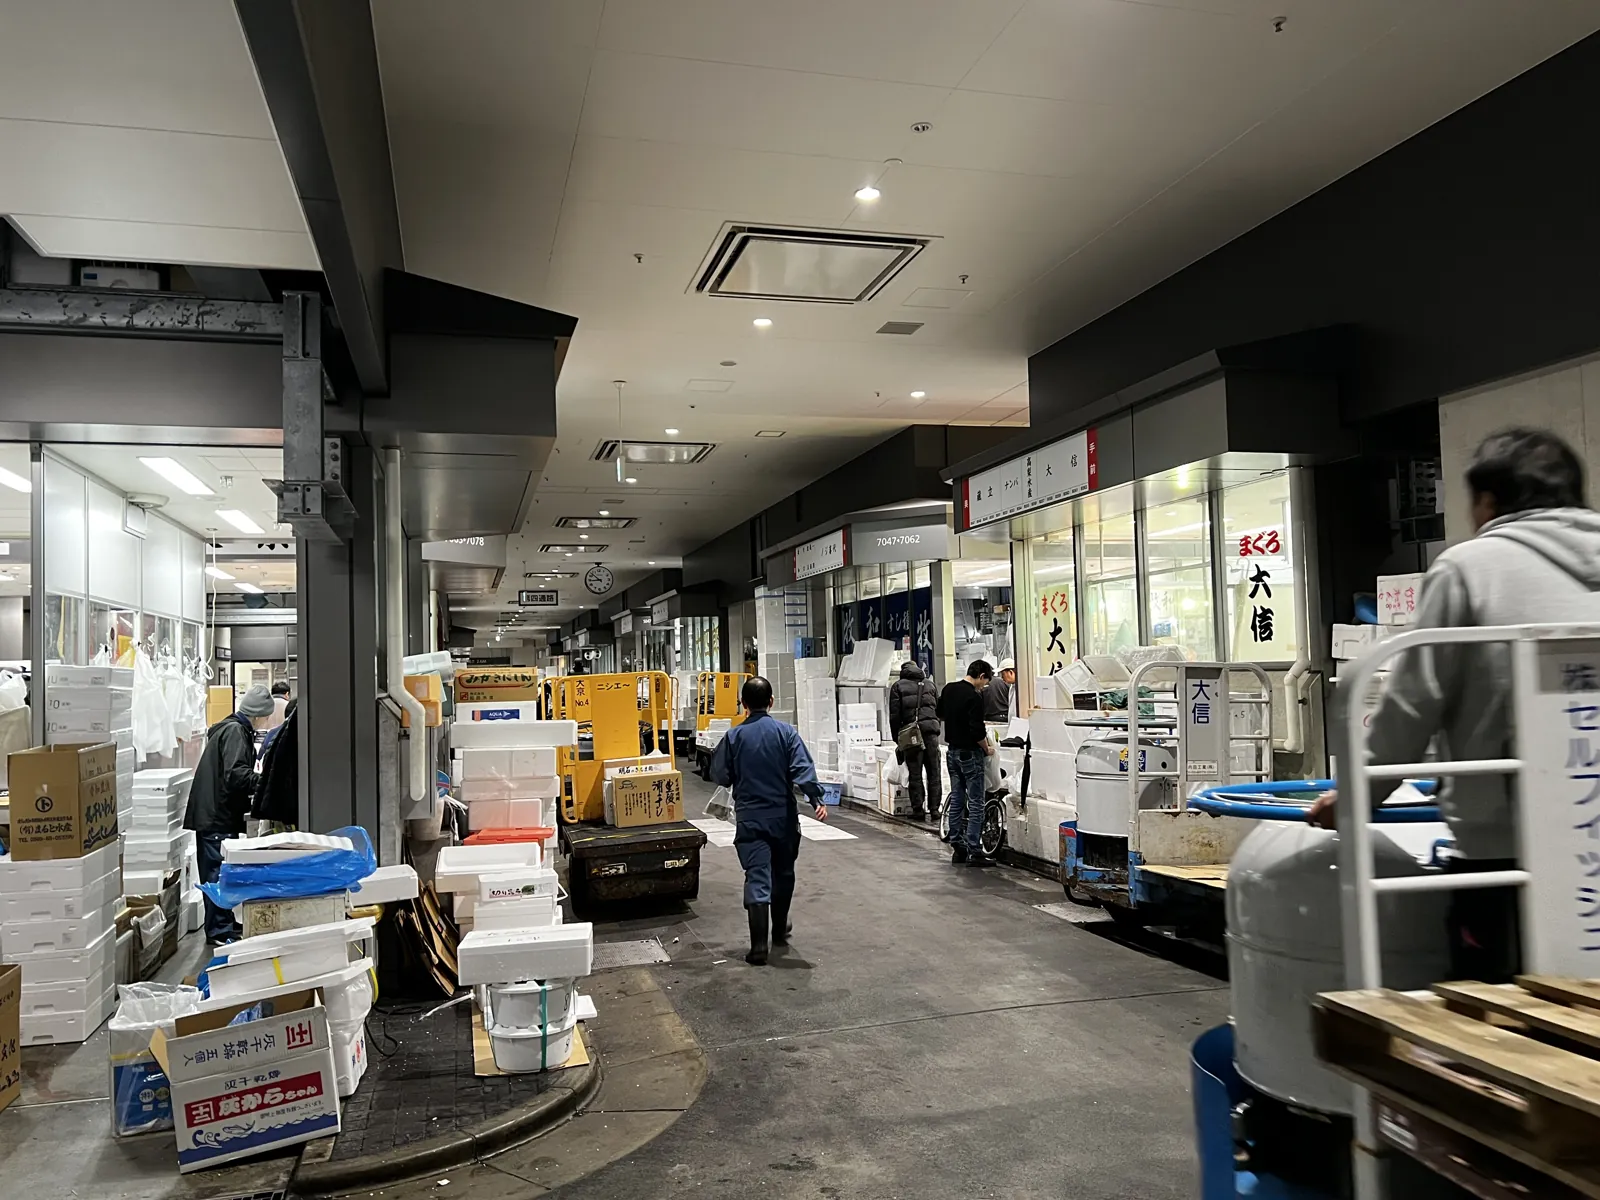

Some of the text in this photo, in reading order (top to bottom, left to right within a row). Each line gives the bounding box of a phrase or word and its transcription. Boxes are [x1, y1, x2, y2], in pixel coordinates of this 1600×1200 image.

[1239, 530, 1281, 557] まぐろ
[526, 594, 554, 602] 四通路
[1041, 591, 1068, 616] まぐろ
[1248, 563, 1275, 643] 大信
[575, 680, 585, 696] 大京
[1191, 679, 1210, 724] 大信
